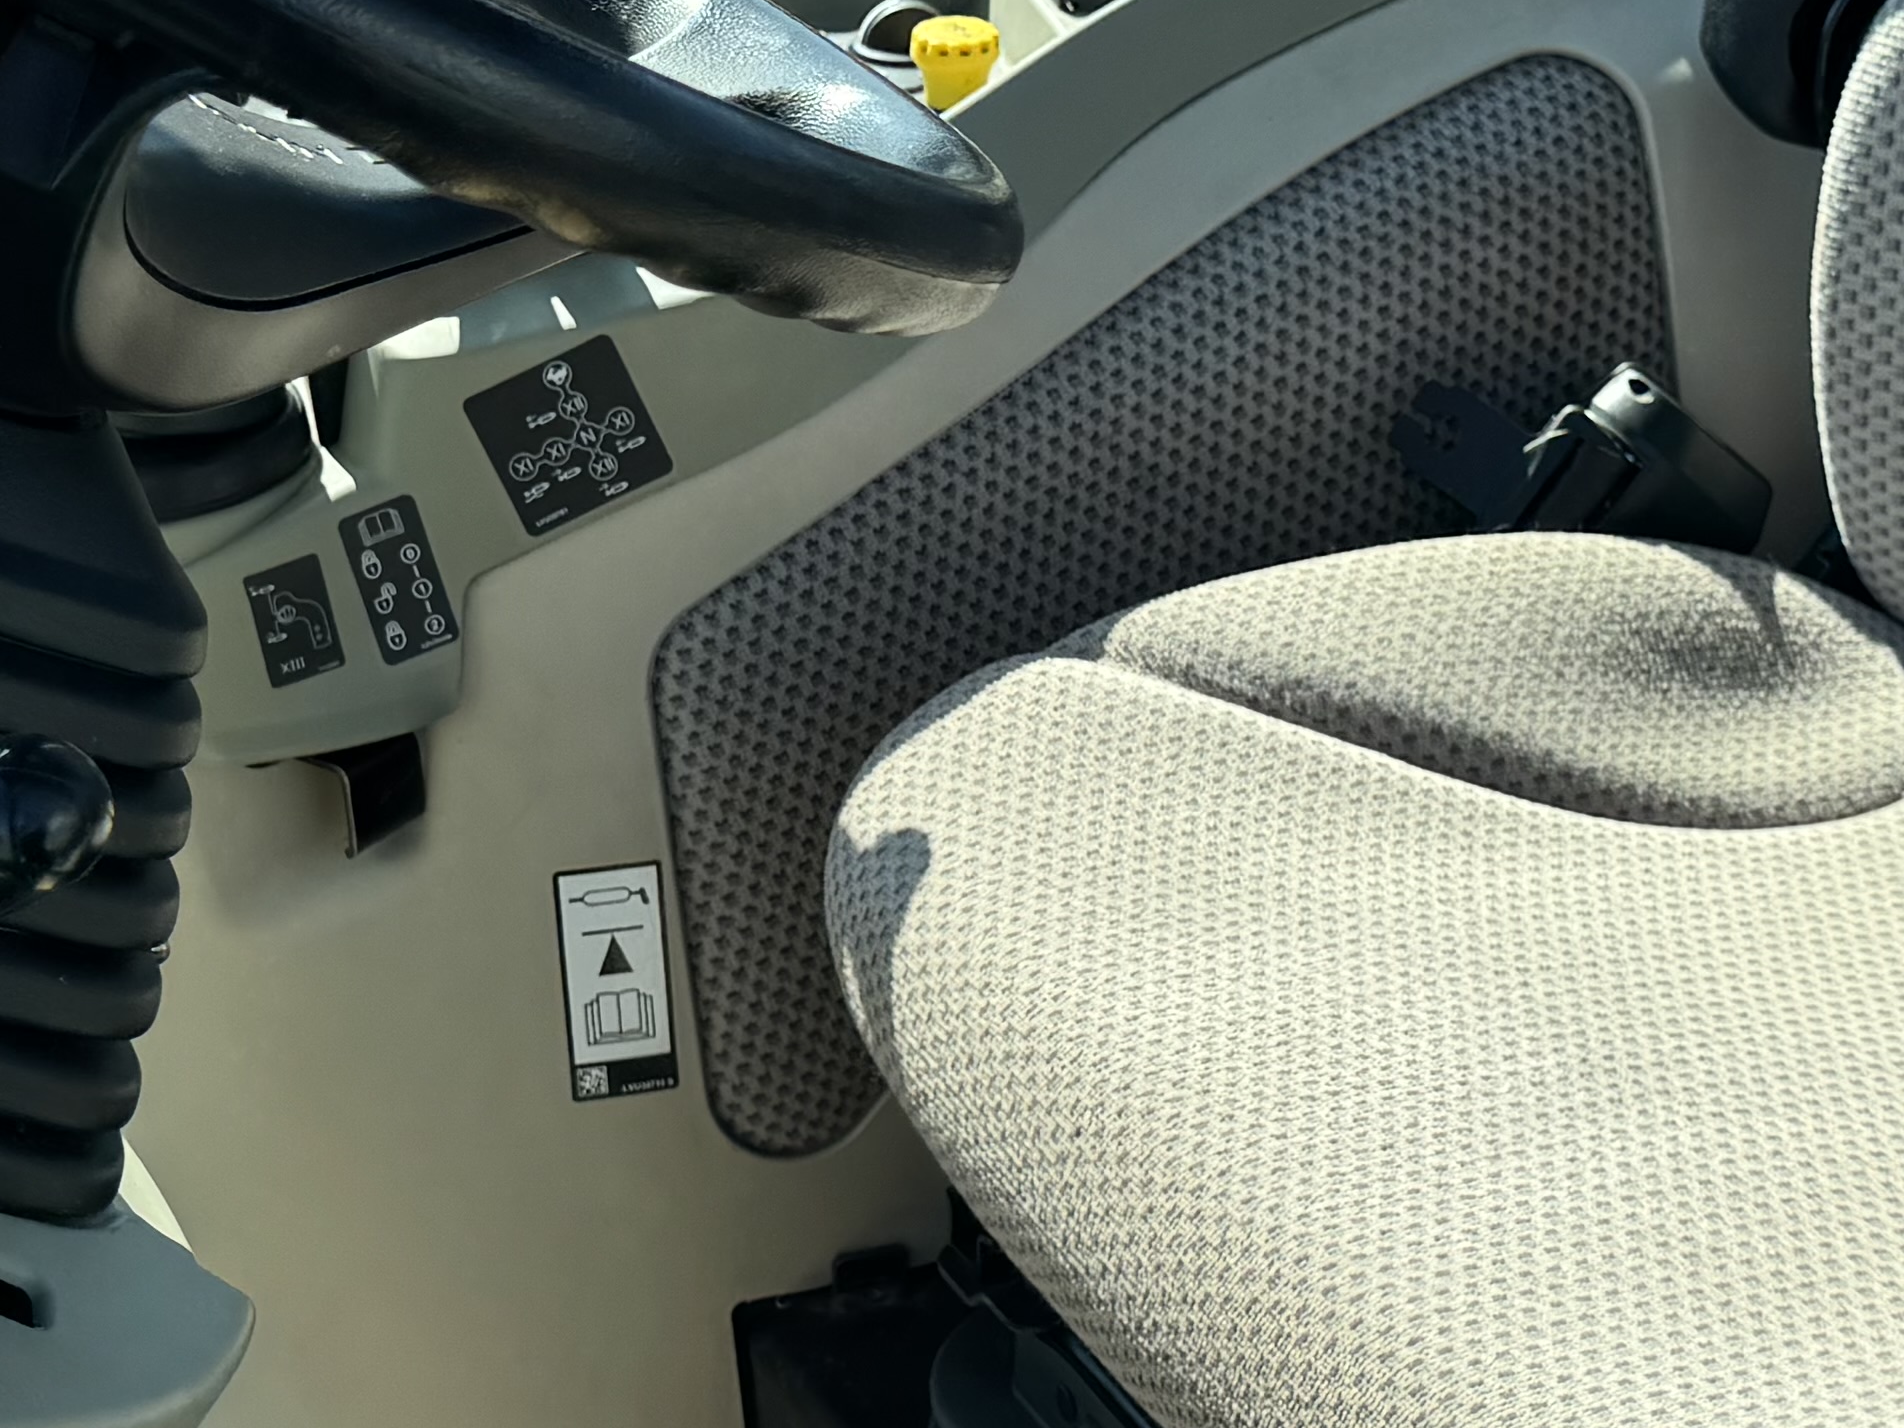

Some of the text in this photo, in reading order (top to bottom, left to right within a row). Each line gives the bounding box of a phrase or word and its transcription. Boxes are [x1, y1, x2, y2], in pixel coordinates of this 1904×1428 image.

[562, 396, 585, 417] XII
[610, 411, 631, 429] XI
[579, 427, 597, 445] N
[545, 442, 567, 461] XI
[514, 457, 534, 476] XI
[592, 457, 616, 476] XII
[405, 548, 415, 560] 0
